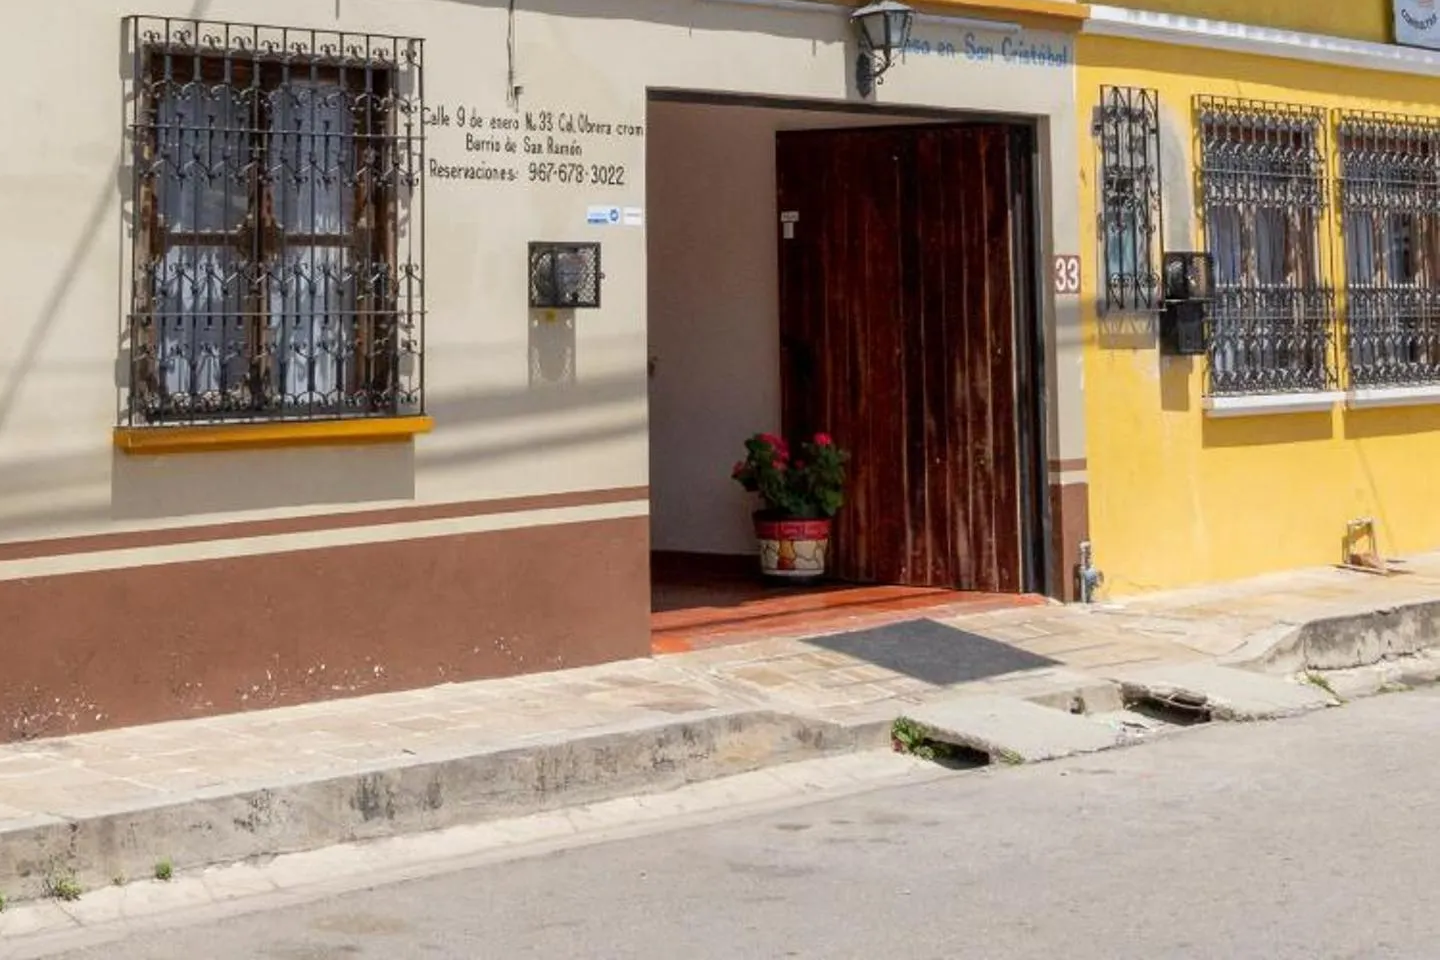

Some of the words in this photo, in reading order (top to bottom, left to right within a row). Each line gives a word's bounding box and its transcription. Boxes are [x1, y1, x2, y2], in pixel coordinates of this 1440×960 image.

[456, 106, 466, 128] 9
[470, 108, 483, 129] de
[490, 115, 519, 131] enero
[466, 133, 500, 154] Barrio
[505, 136, 517, 154] de
[523, 136, 543, 155] San
[547, 136, 583, 157] Ramón
[1055, 258, 1079, 292] 33
